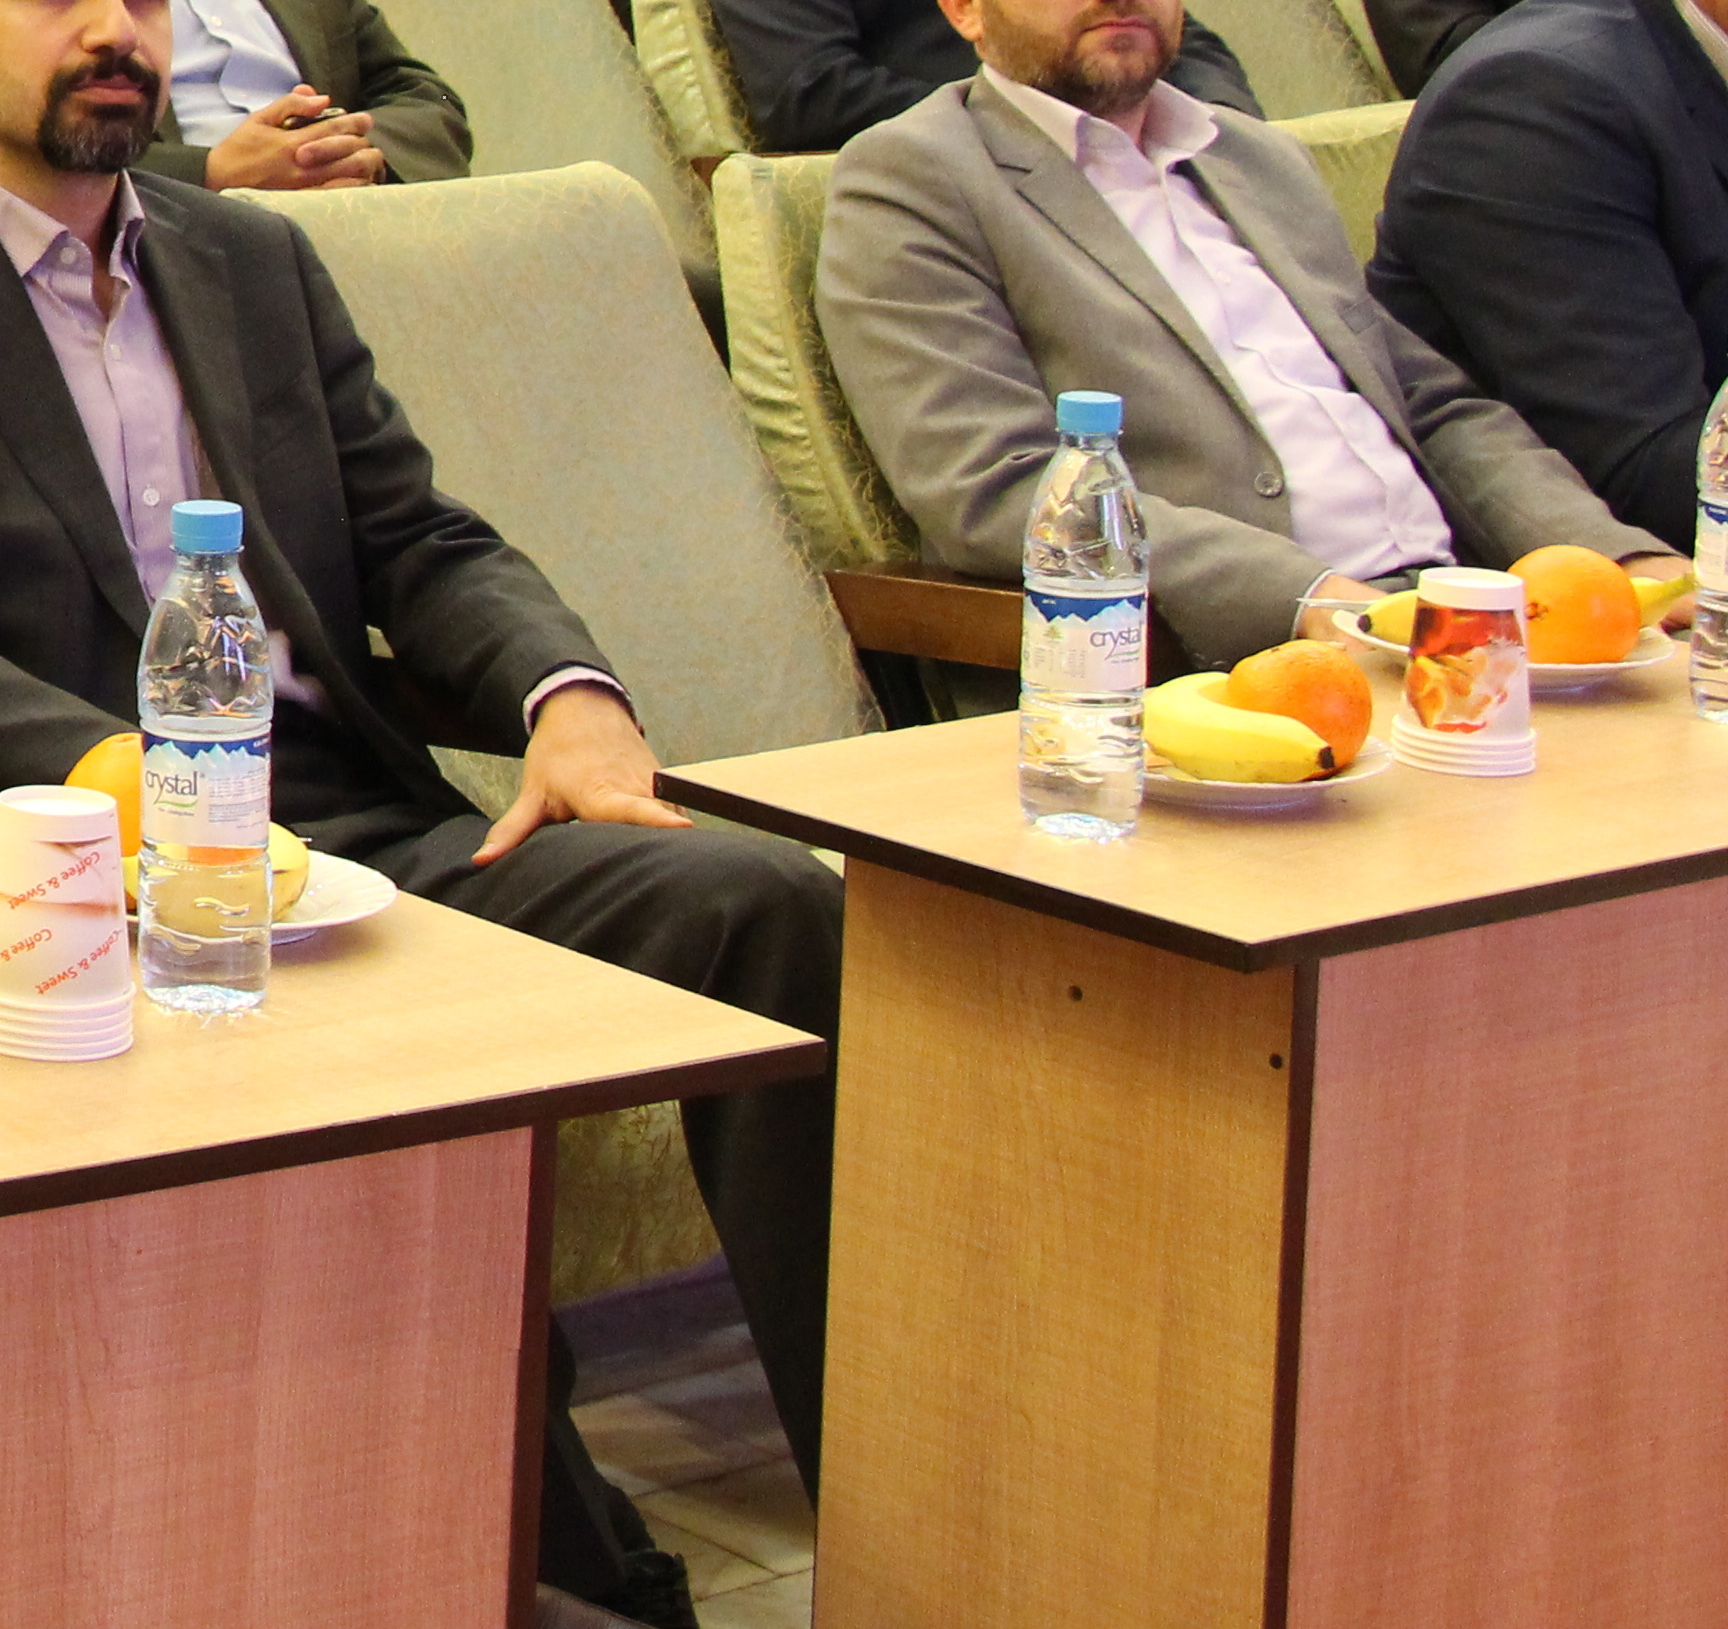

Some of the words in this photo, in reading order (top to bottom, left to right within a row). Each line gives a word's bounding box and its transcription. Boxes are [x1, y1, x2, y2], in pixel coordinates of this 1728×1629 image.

[60, 851, 101, 881] Coffee
[7, 883, 47, 910] Sweet
[47, 879, 61, 889] &
[12, 928, 53, 955] Coffee
[0, 952, 11, 962] &
[77, 959, 91, 970] &
[34, 967, 79, 995] Sweet
